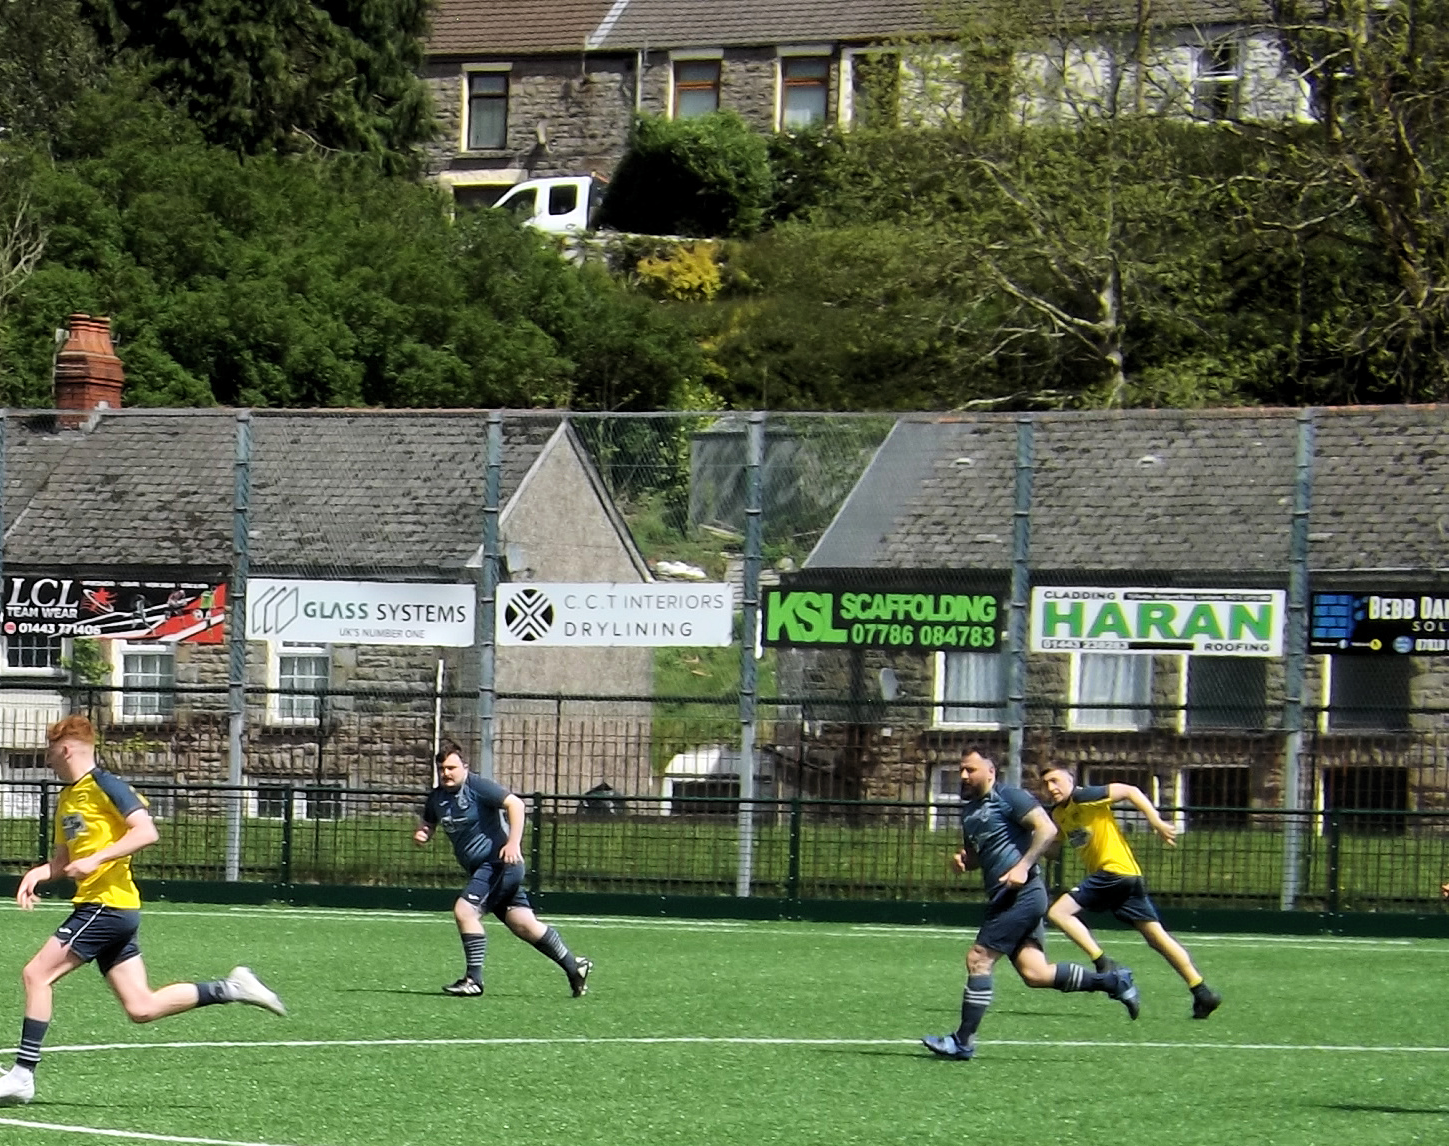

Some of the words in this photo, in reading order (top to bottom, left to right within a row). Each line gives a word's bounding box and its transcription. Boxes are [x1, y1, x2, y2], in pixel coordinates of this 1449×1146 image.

[6, 578, 79, 607] LCL
[1043, 590, 1116, 600] CLADDING
[624, 595, 724, 609] INTERIORS
[840, 592, 997, 623] SCAFFOLDING
[6, 607, 38, 617] TEAM
[41, 608, 78, 618] WEAR
[303, 601, 369, 619] GLASS
[376, 604, 466, 623] SYSTEMS
[767, 591, 848, 642] KSL
[18, 623, 55, 633] 01443
[1042, 601, 1273, 641] HARAN
[339, 628, 360, 636] UK'S
[362, 629, 402, 637] NUMBER
[404, 630, 425, 638] ONE
[564, 622, 693, 637] DRYLINING
[852, 623, 914, 645] 07786
[919, 625, 995, 647] 084783
[1203, 643, 1269, 652] ROOFING
